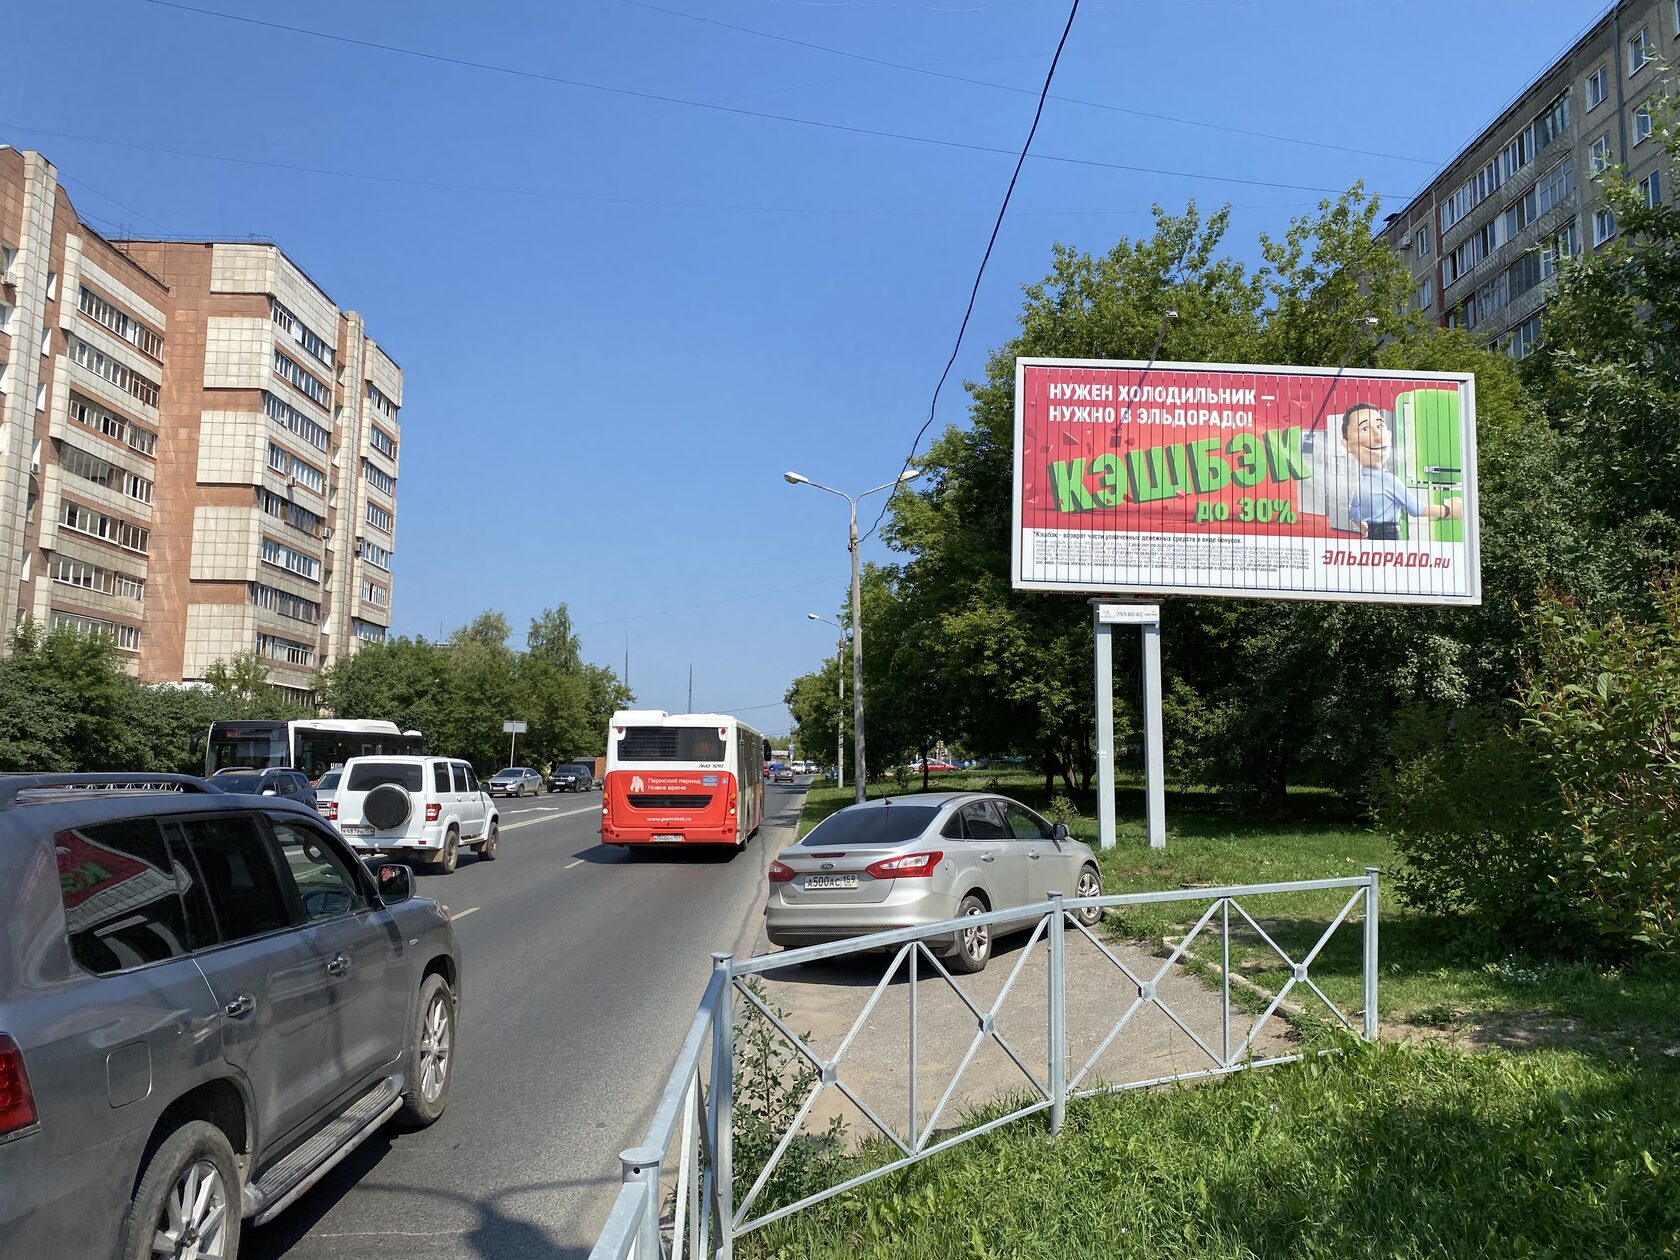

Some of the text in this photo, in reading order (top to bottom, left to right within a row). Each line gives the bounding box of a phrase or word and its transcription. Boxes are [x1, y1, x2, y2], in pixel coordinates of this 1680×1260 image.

[1049, 383, 1113, 401] НУЖЕН
[1117, 385, 1256, 406] ХОЛОДИЛЬНИК
[1049, 405, 1253, 430] НУЖНО В ЭЛЬДОРАДО!
[1048, 426, 1312, 513] КЭШБЭК
[1195, 496, 1297, 525] до 30%
[842, 875, 856, 884] 159
